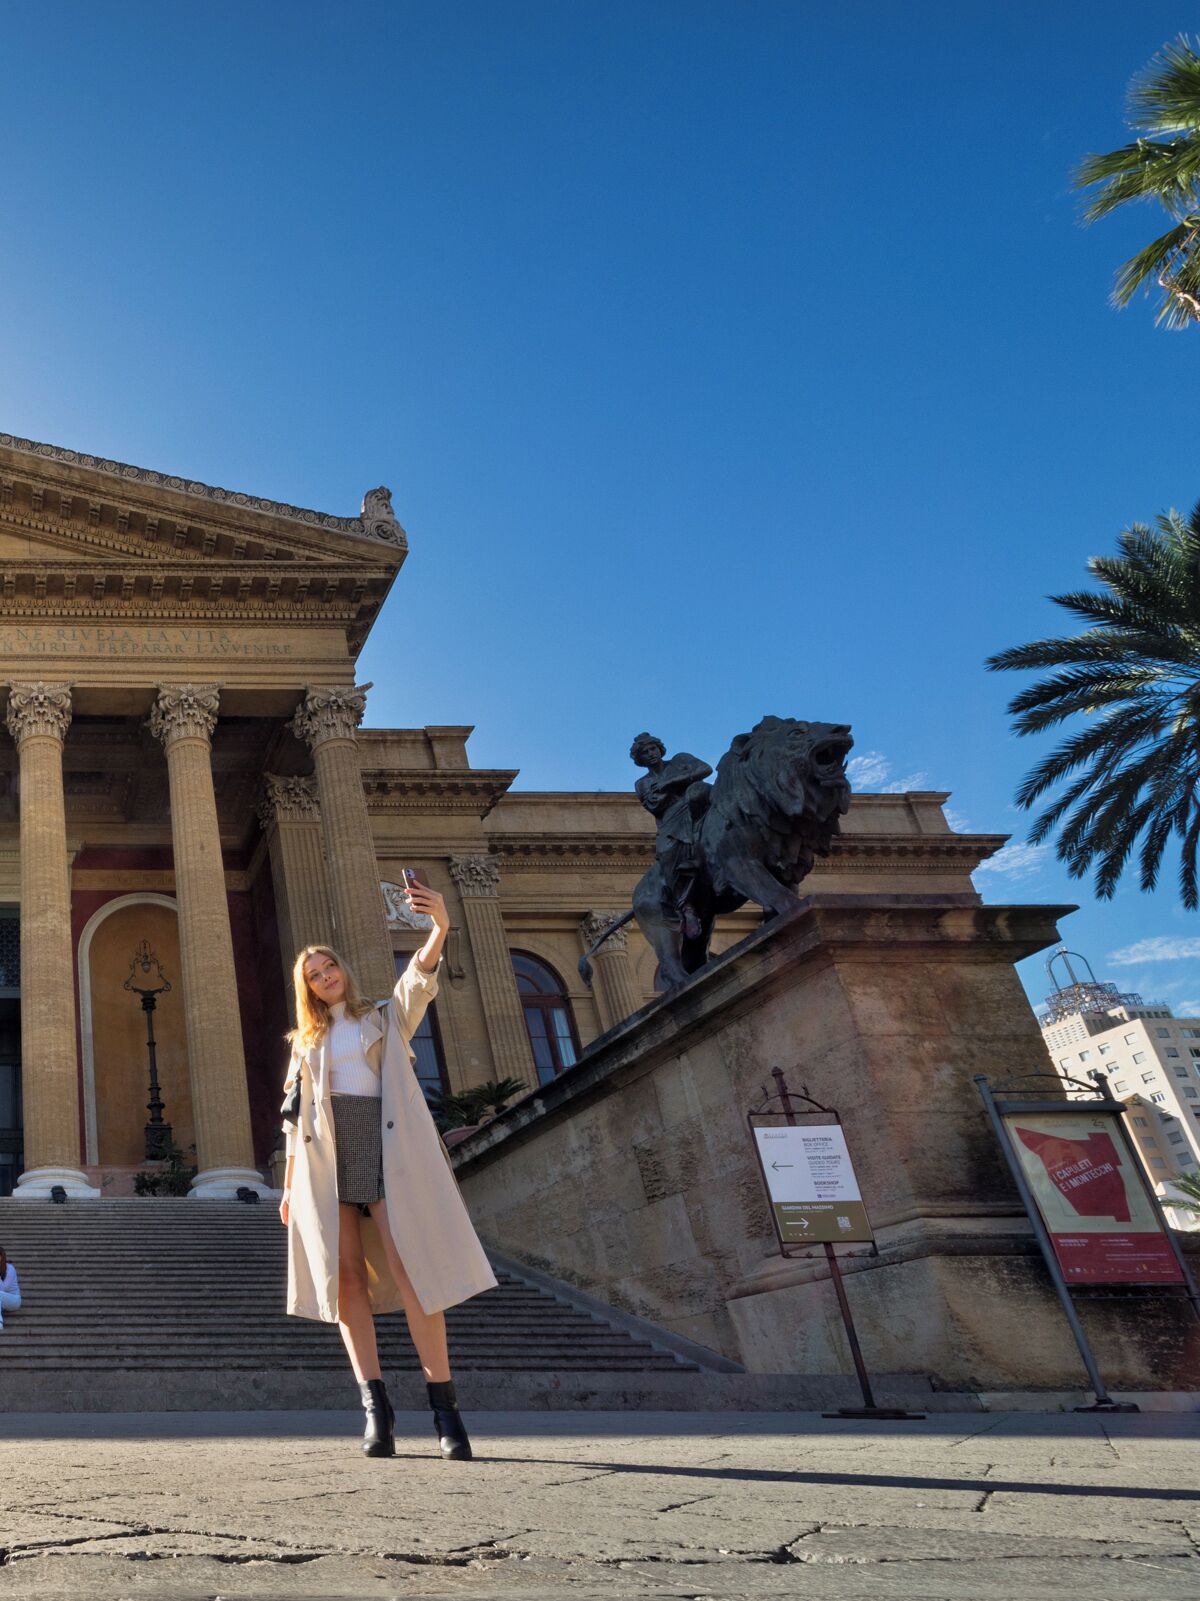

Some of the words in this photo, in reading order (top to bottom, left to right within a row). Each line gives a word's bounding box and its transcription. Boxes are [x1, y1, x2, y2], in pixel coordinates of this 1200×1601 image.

[16, 628, 44, 641] NE
[56, 629, 132, 642] RIVELA
[147, 630, 170, 642] LA
[181, 630, 231, 643] VITA
[28, 641, 67, 653] MIRI
[79, 643, 88, 653] A
[98, 642, 185, 653] PREPARAR
[197, 643, 292, 654] L'AVVENIRE
[1057, 1158, 1093, 1180] CAPULETI
[1059, 1183, 1068, 1192] E
[1070, 1162, 1114, 1188] MONTECCHI
